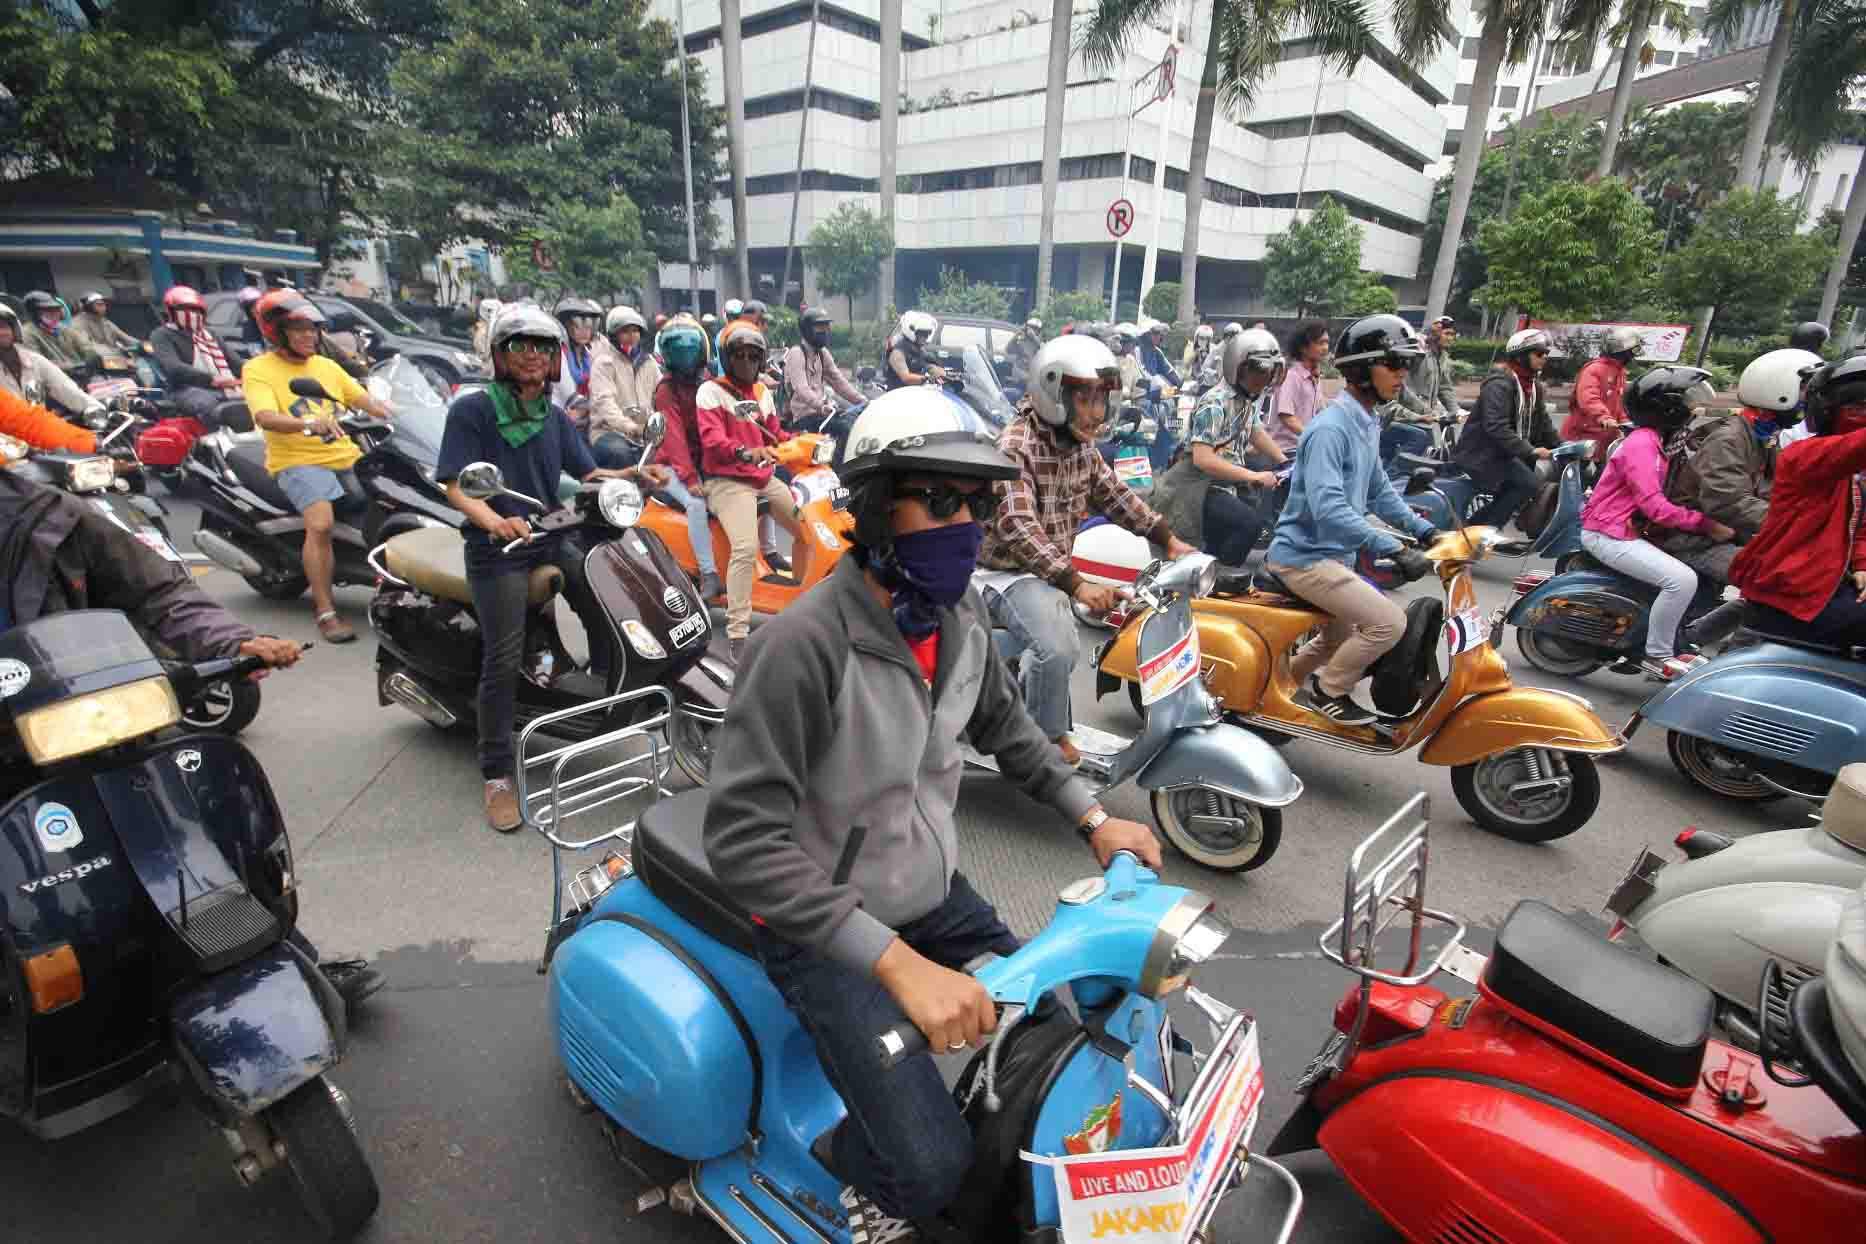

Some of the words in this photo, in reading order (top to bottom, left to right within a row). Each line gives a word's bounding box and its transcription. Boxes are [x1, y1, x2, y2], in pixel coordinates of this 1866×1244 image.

[20, 857, 112, 892] vespa
[1080, 1176, 1113, 1197] LIVE
[1114, 1167, 1149, 1192] AND
[1089, 1202, 1186, 1238] JAKART
